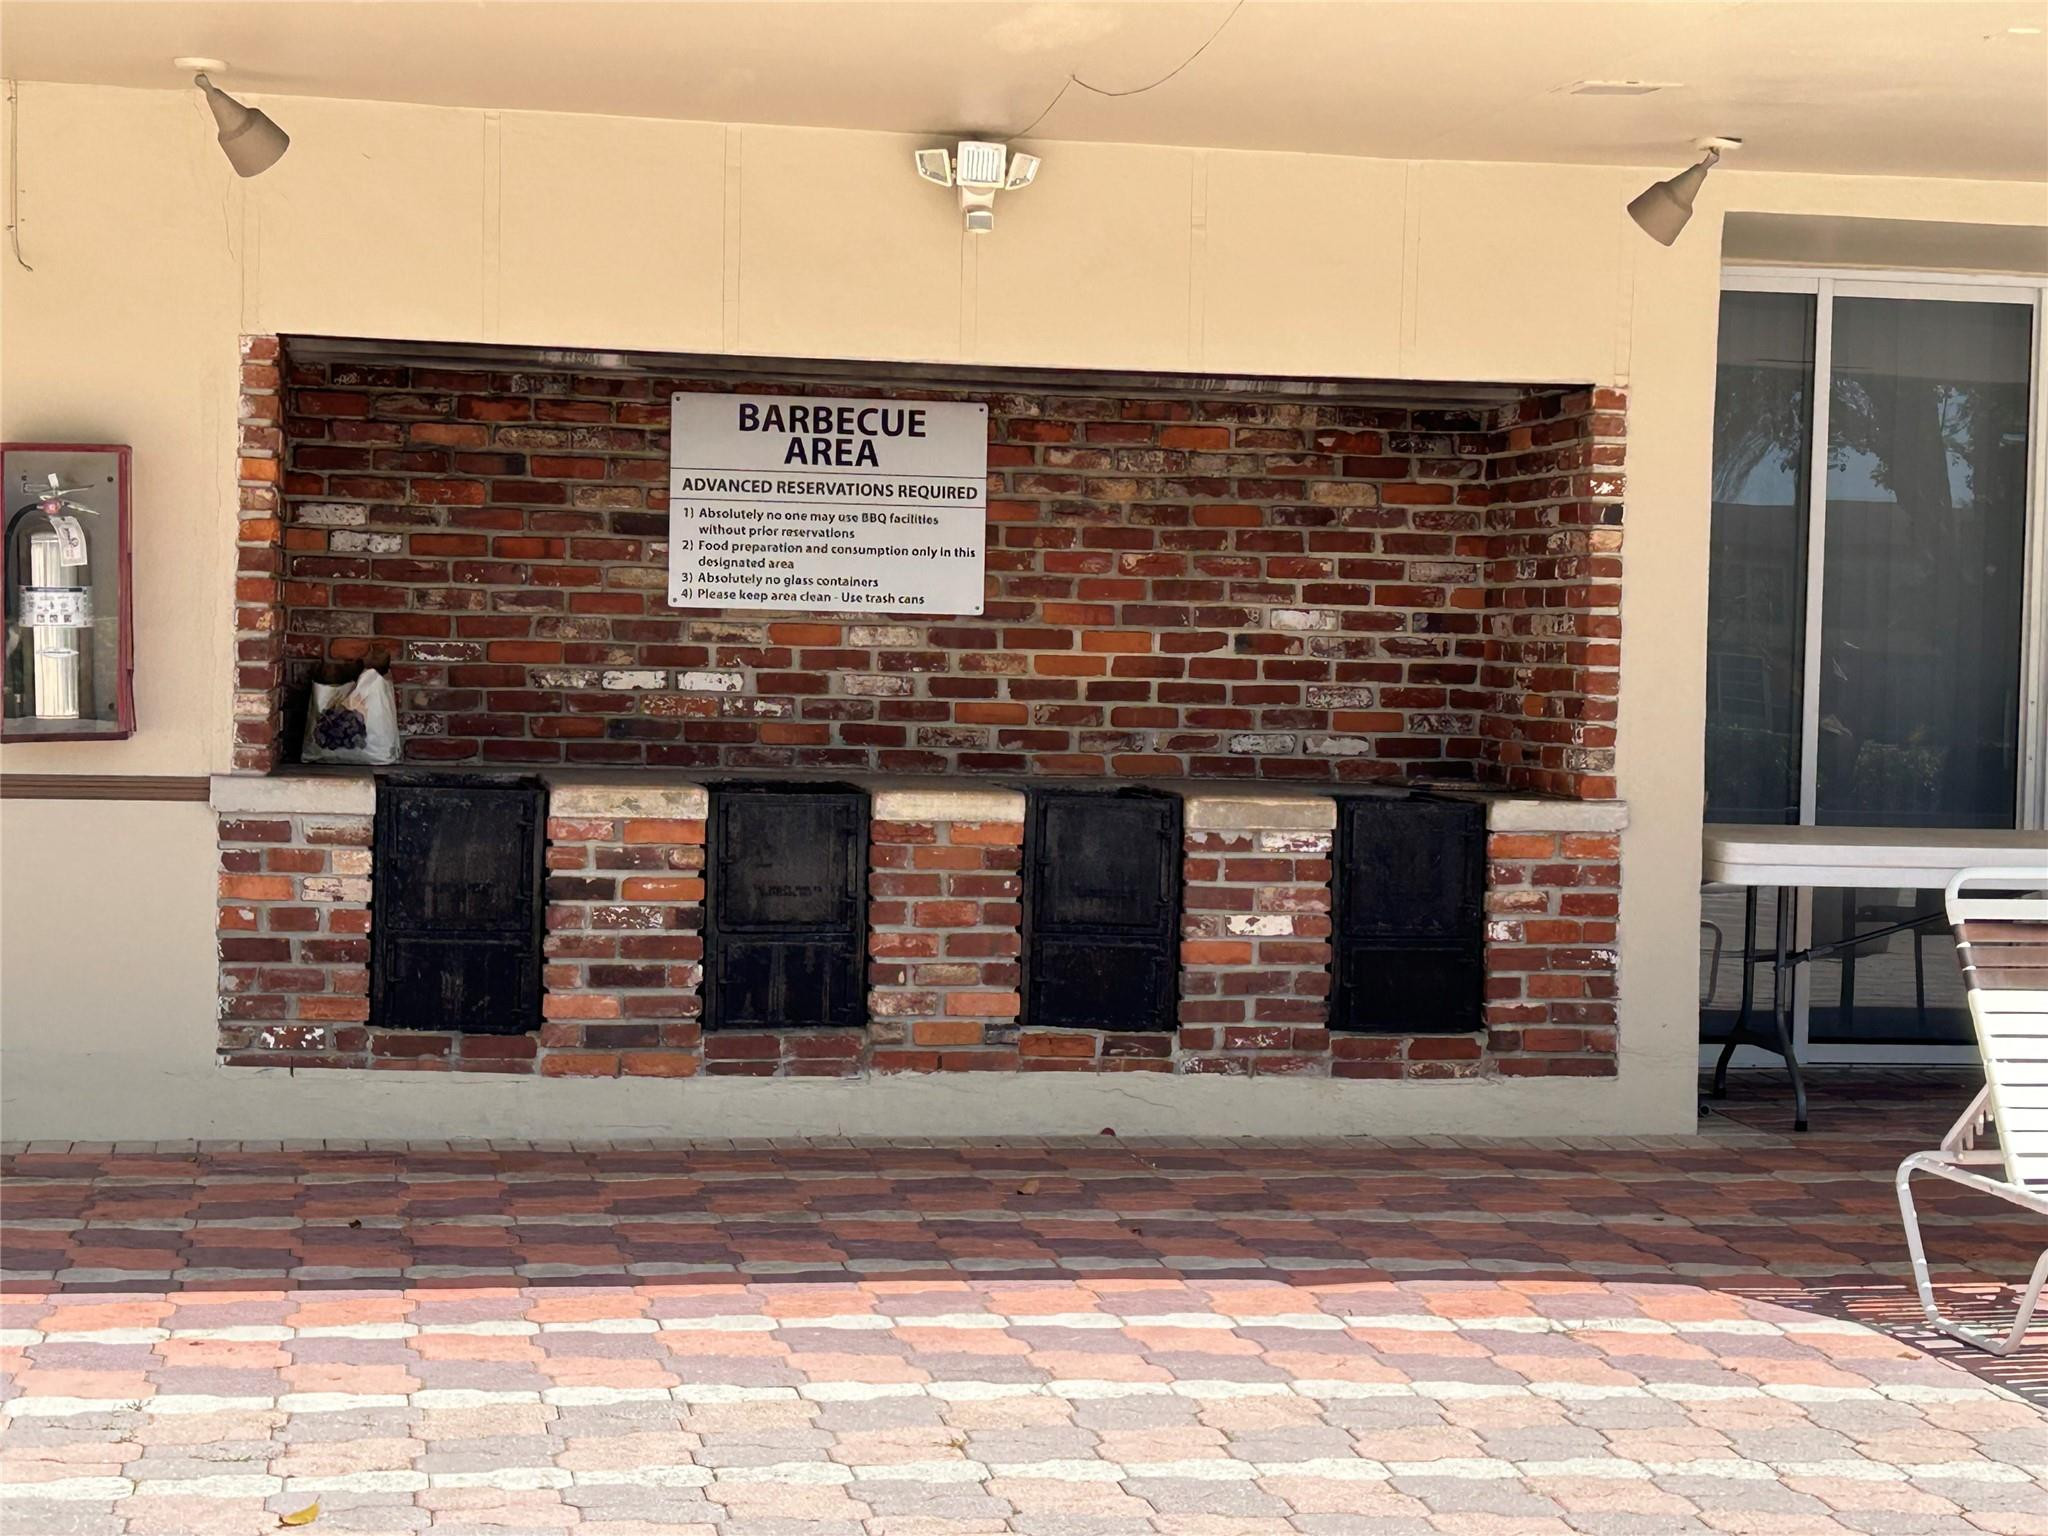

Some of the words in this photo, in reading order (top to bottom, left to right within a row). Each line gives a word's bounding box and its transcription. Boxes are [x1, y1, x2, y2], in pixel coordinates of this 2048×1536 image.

[739, 402, 927, 439] BARBECUE
[783, 436, 879, 468] AREA
[682, 477, 773, 494] ADVANCED
[776, 480, 894, 498] RESERVATIONS
[898, 484, 978, 500] REQUIRED
[683, 506, 694, 519] 1)
[698, 507, 764, 523] Absolutely
[766, 512, 782, 521] no
[784, 512, 808, 521] one
[810, 513, 836, 525] may
[838, 514, 859, 523] use
[861, 512, 887, 525] BBQ
[889, 512, 939, 526] facilities
[698, 523, 746, 536] without
[748, 525, 779, 538] prior
[781, 527, 855, 539] reservations
[682, 539, 694, 551] 2)
[698, 540, 729, 551] Food
[731, 542, 803, 555] preparation
[805, 543, 828, 554] and
[830, 545, 909, 558] consumption
[911, 546, 938, 560] only
[940, 546, 951, 558] in
[954, 547, 976, 558] this
[698, 555, 766, 570] designated
[768, 560, 795, 569] area
[681, 571, 693, 584] 3)
[697, 571, 763, 587] Absolutely
[765, 576, 781, 585] no
[783, 574, 814, 588] glass
[816, 576, 879, 588] containers
[680, 588, 693, 600] 4)
[697, 588, 737, 600] Please
[739, 589, 769, 603] keep
[770, 592, 797, 602] area
[799, 591, 832, 602] clean
[841, 592, 863, 603] Use
[865, 592, 896, 604] trash
[898, 595, 925, 605] cans
